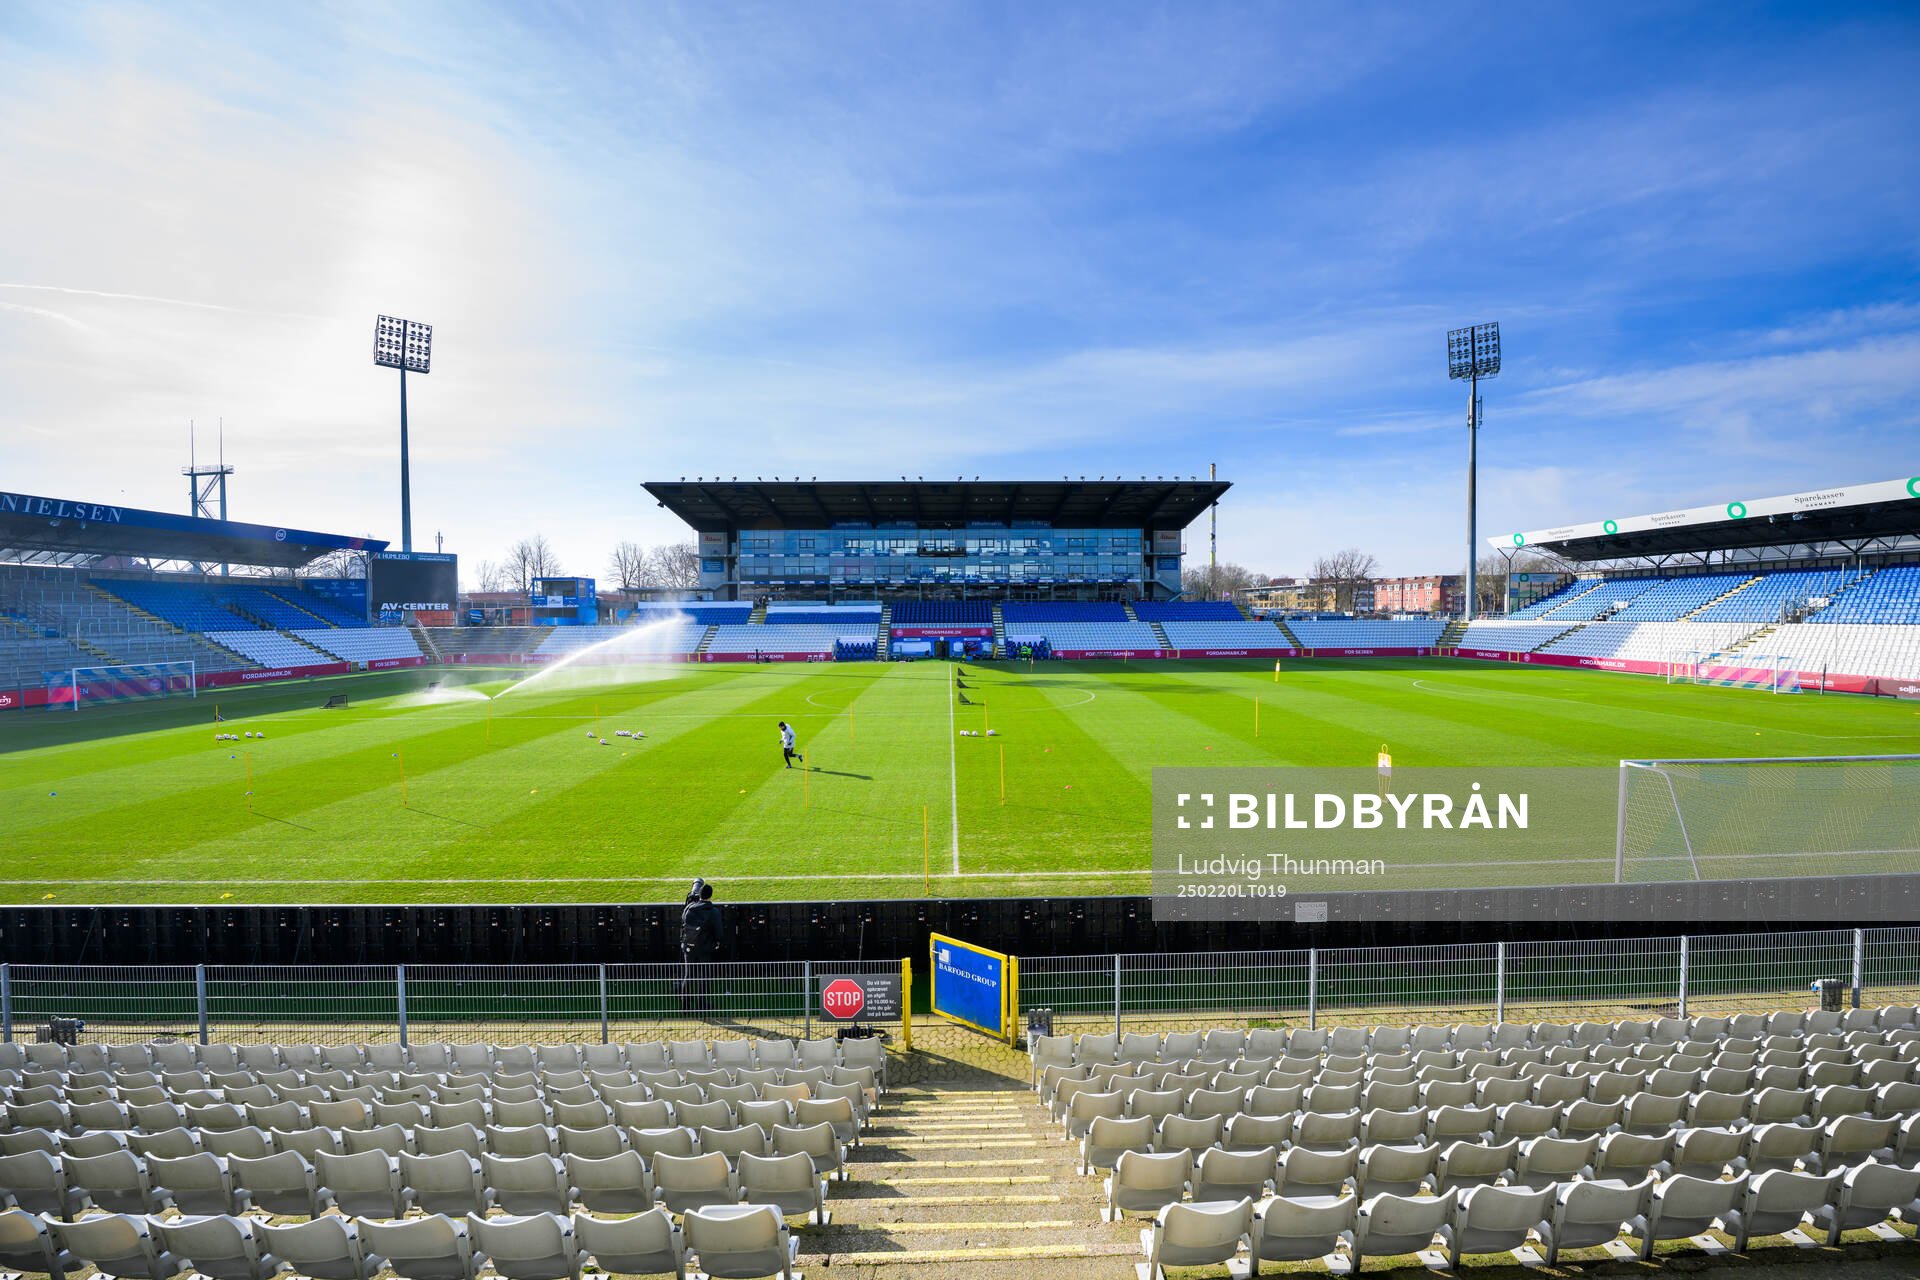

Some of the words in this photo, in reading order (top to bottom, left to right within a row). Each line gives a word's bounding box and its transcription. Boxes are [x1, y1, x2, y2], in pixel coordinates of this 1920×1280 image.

[1794, 491, 1844, 504] Sparekassen
[0, 494, 122, 522] NIELSEN
[1580, 659, 1626, 668] FORDANMARK.DK
[242, 670, 292, 680] FORDANMARK.DK
[938, 962, 971, 979] BARFOED
[971, 973, 997, 988] GROUP
[827, 991, 861, 1007] STOP
